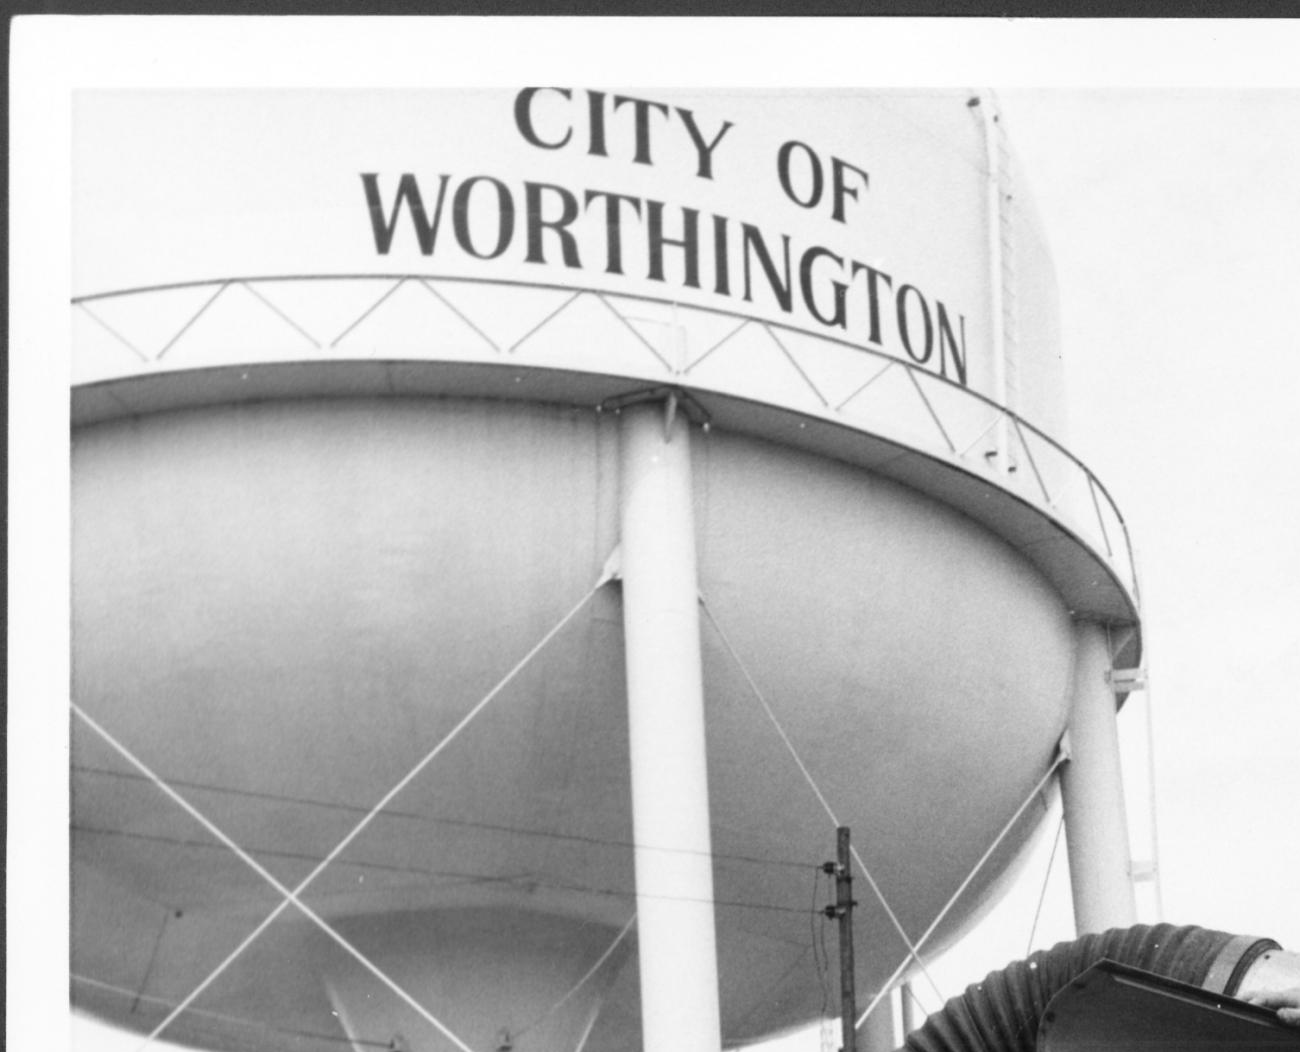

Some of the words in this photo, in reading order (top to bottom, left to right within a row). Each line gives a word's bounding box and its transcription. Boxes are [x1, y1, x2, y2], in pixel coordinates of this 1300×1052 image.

[513, 87, 735, 180] CITY
[777, 140, 870, 224] OF
[359, 172, 969, 389] WORTHINGTON
